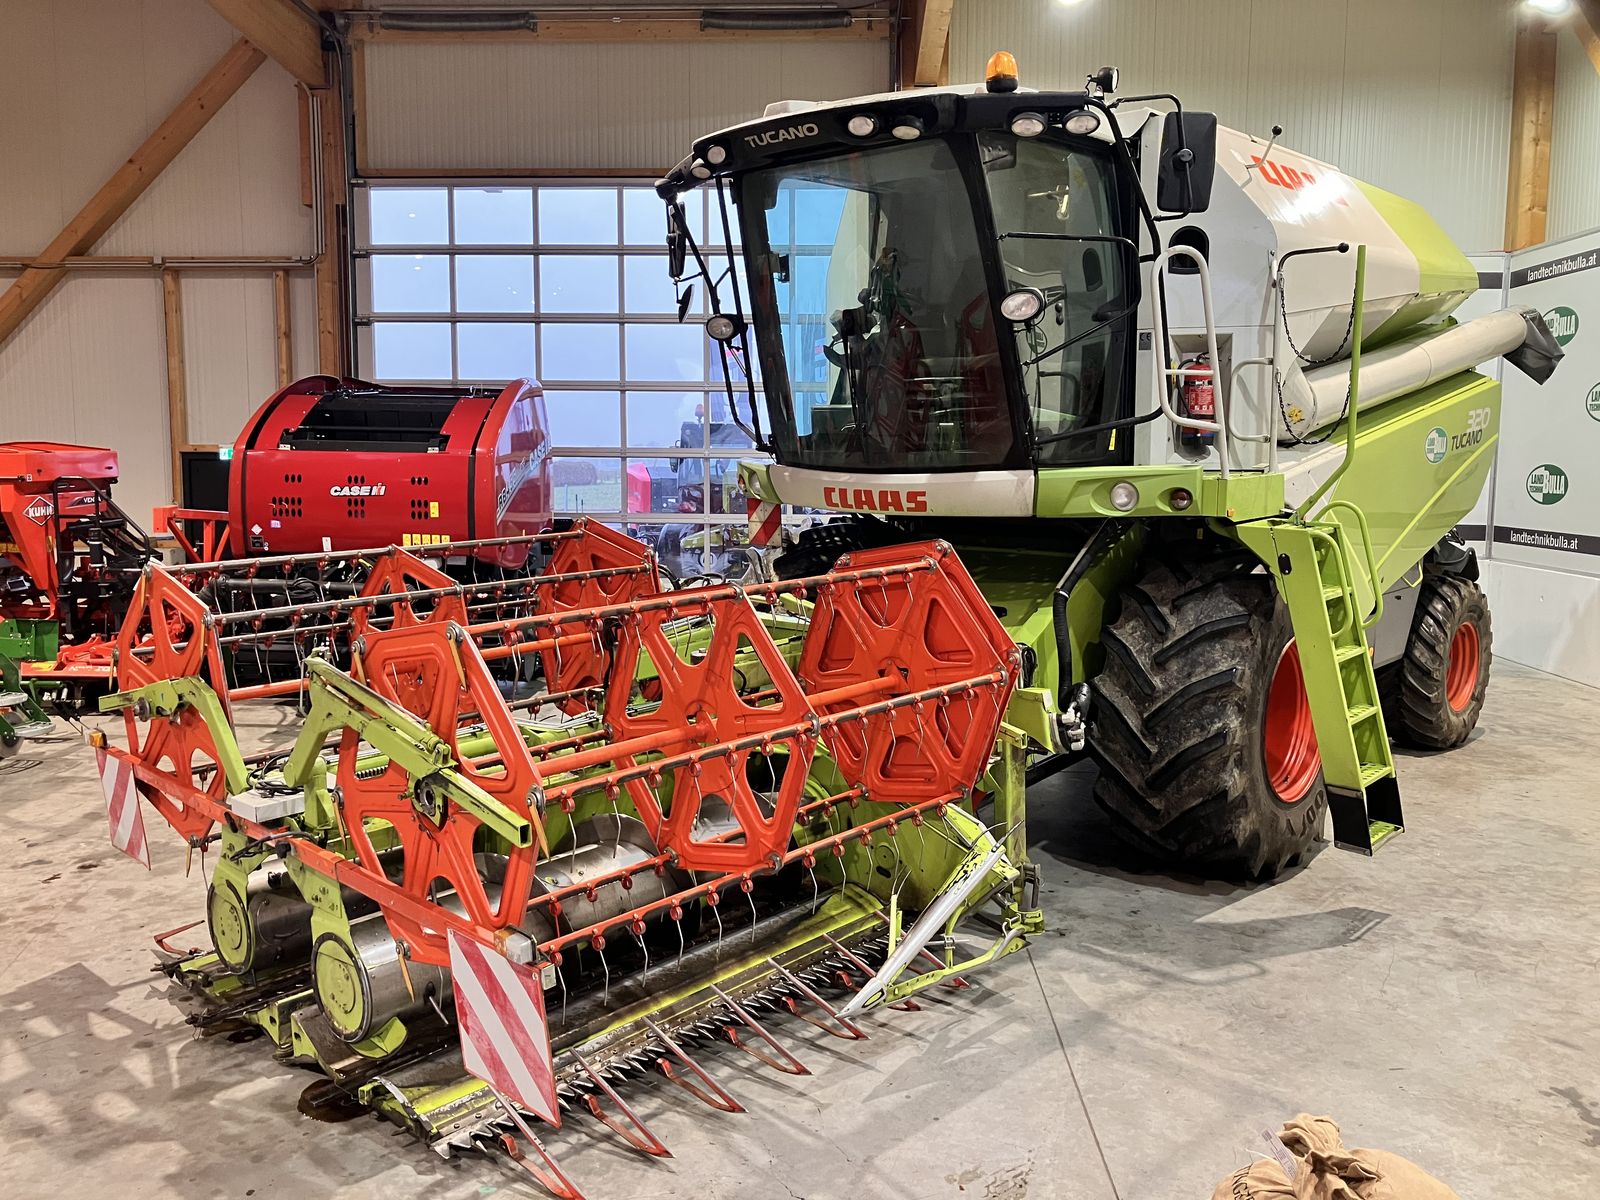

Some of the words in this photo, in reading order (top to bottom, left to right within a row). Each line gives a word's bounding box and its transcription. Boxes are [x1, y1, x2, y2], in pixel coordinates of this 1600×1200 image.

[744, 123, 819, 148] TUCANO
[1527, 253, 1597, 281] landtechnikbulla.at
[1451, 429, 1483, 452] TUCANO
[329, 485, 371, 496] CASE
[1543, 470, 1565, 495] BULLA
[28, 505, 55, 518] KUHN
[823, 486, 927, 513] CLAAS
[1510, 530, 1578, 550] landtechnikbulla.at
